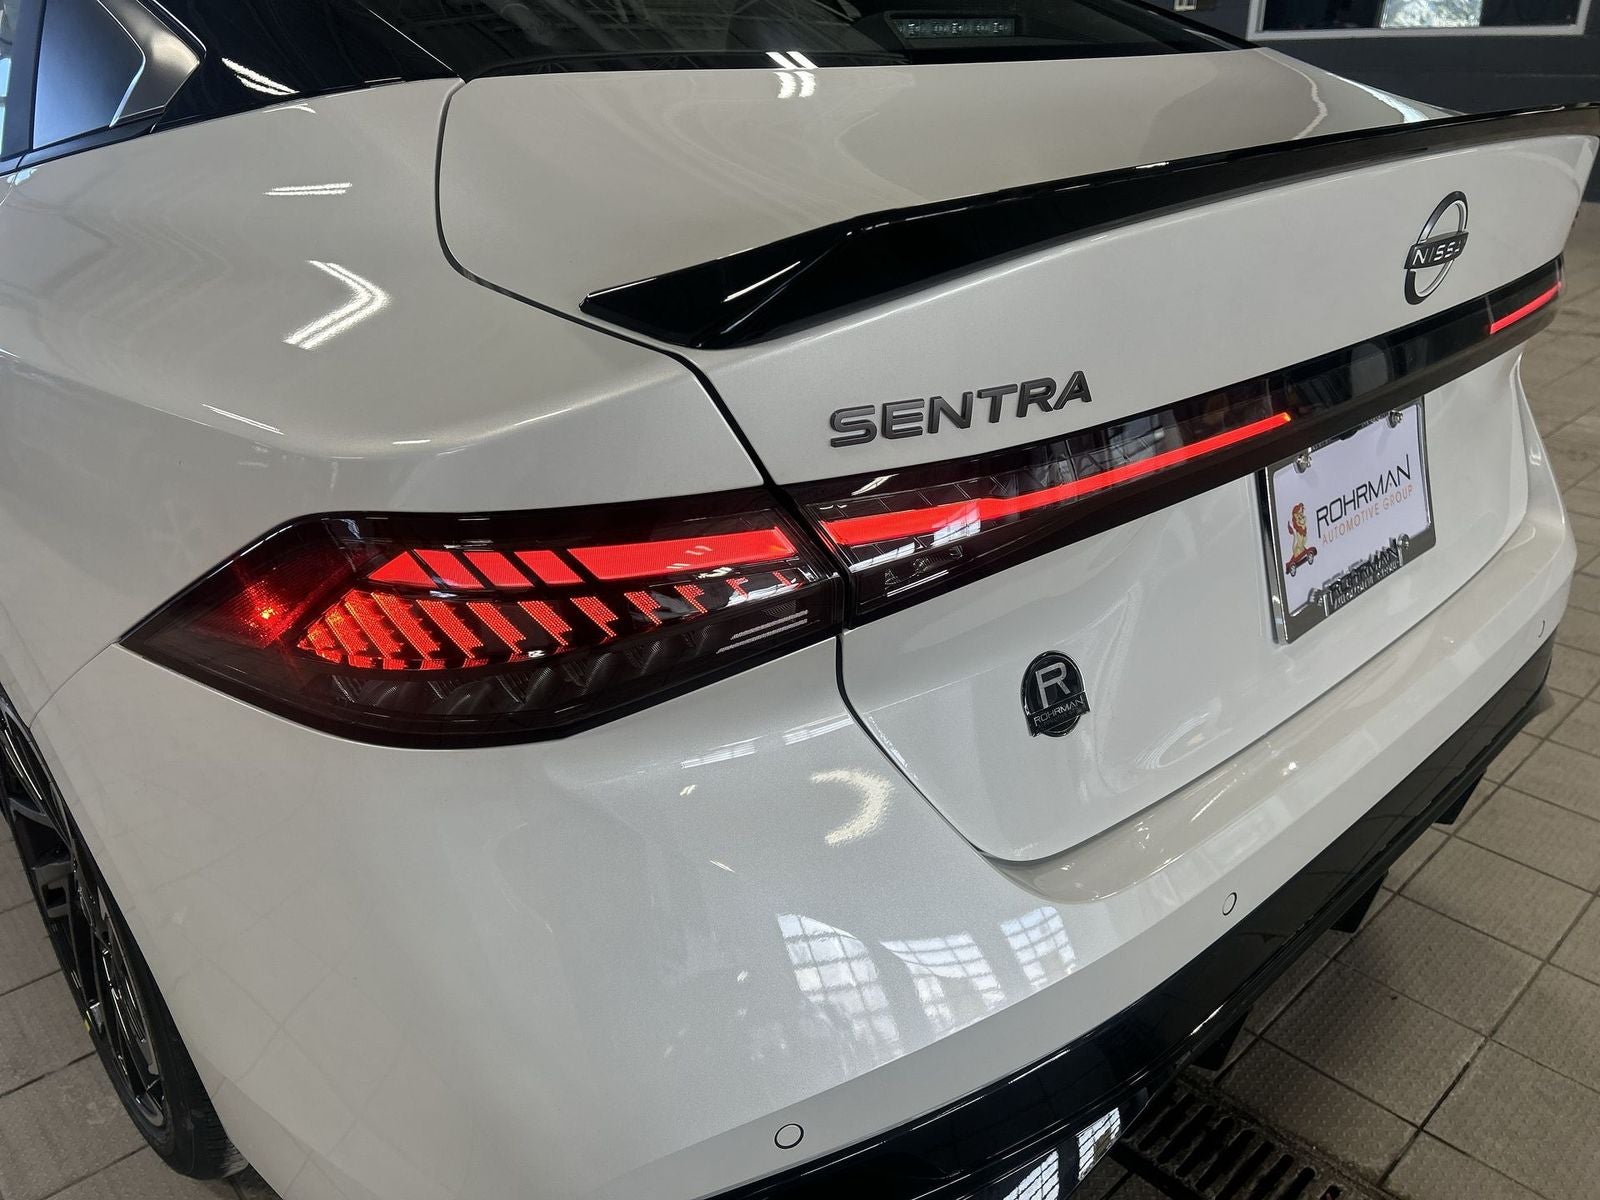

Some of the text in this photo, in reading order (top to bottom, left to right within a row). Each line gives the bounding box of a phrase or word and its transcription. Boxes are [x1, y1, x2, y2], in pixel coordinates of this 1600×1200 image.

[829, 370, 1092, 448] SENTRA
[1316, 453, 1411, 539] ROHRMAN
[1322, 484, 1414, 545] AUTOMOTIVE GROUP
[1033, 694, 1085, 727] ROHRMAN
[1035, 661, 1071, 710] R
